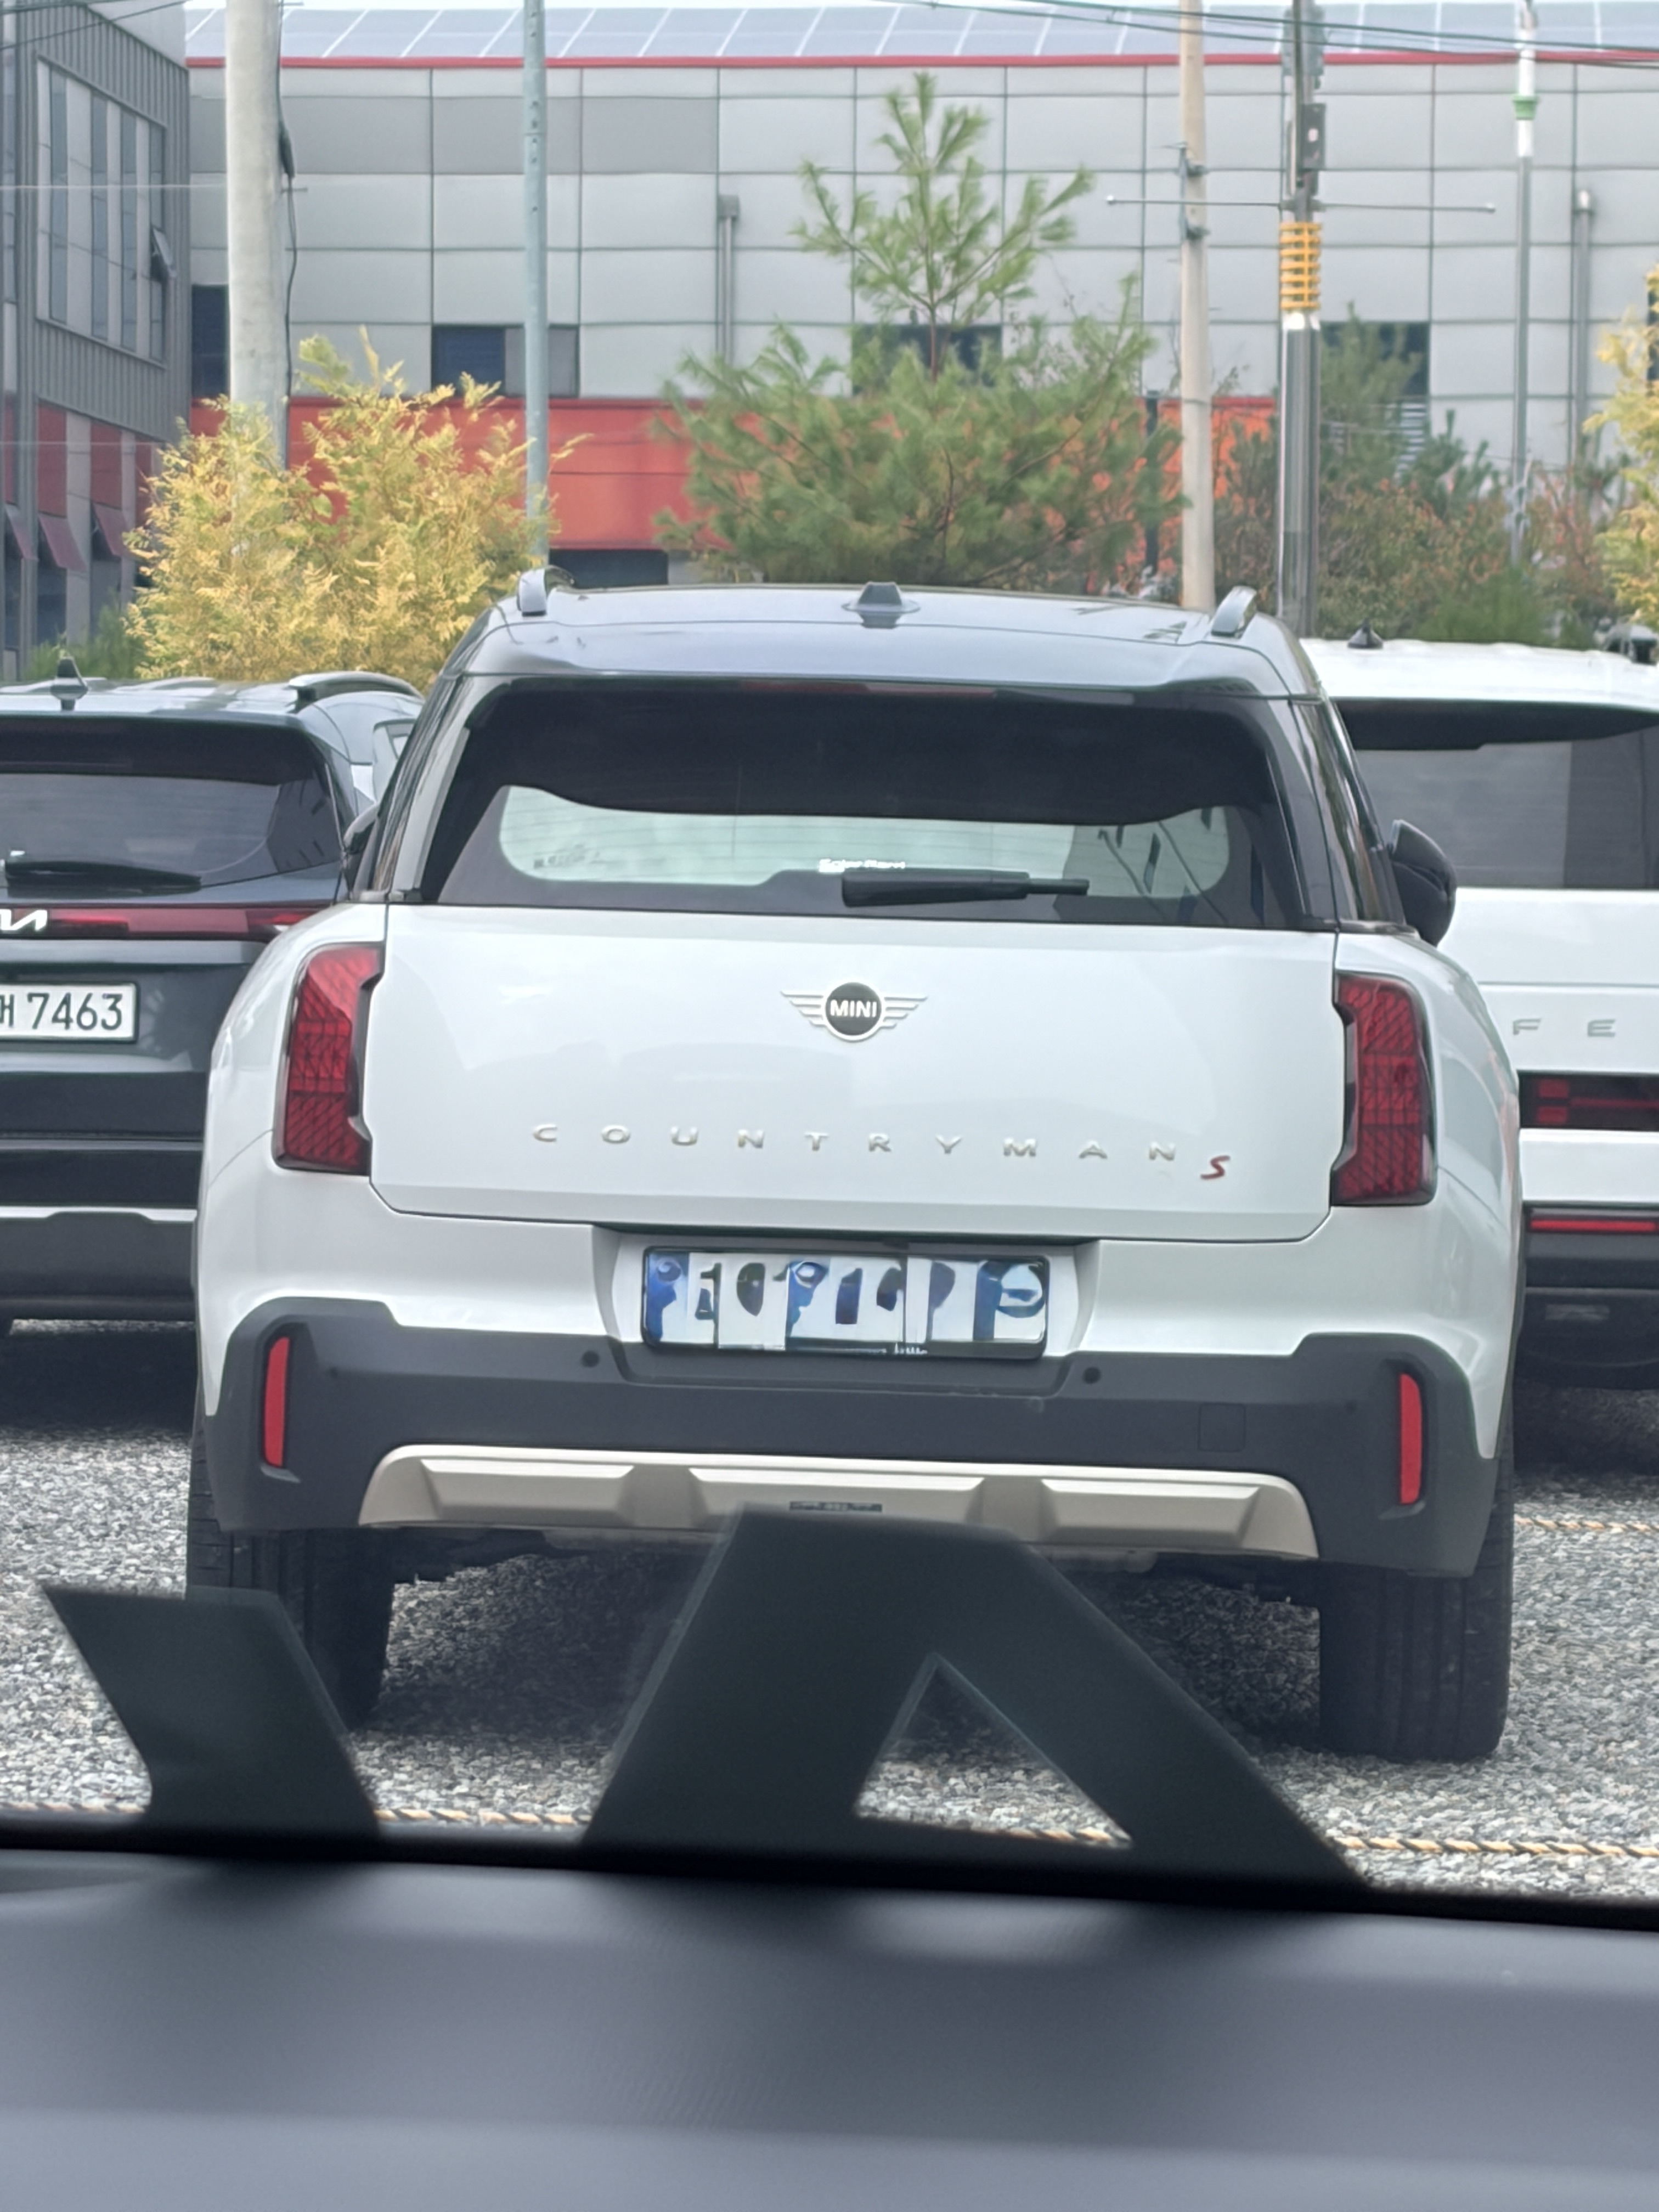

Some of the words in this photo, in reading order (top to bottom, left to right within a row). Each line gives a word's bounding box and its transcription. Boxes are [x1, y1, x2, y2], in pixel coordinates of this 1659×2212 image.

[27, 992, 123, 1031] 7463
[830, 998, 877, 1018] MINI
[532, 1123, 1176, 1162] COUNTRYMAN
[1200, 1155, 1231, 1180] S
